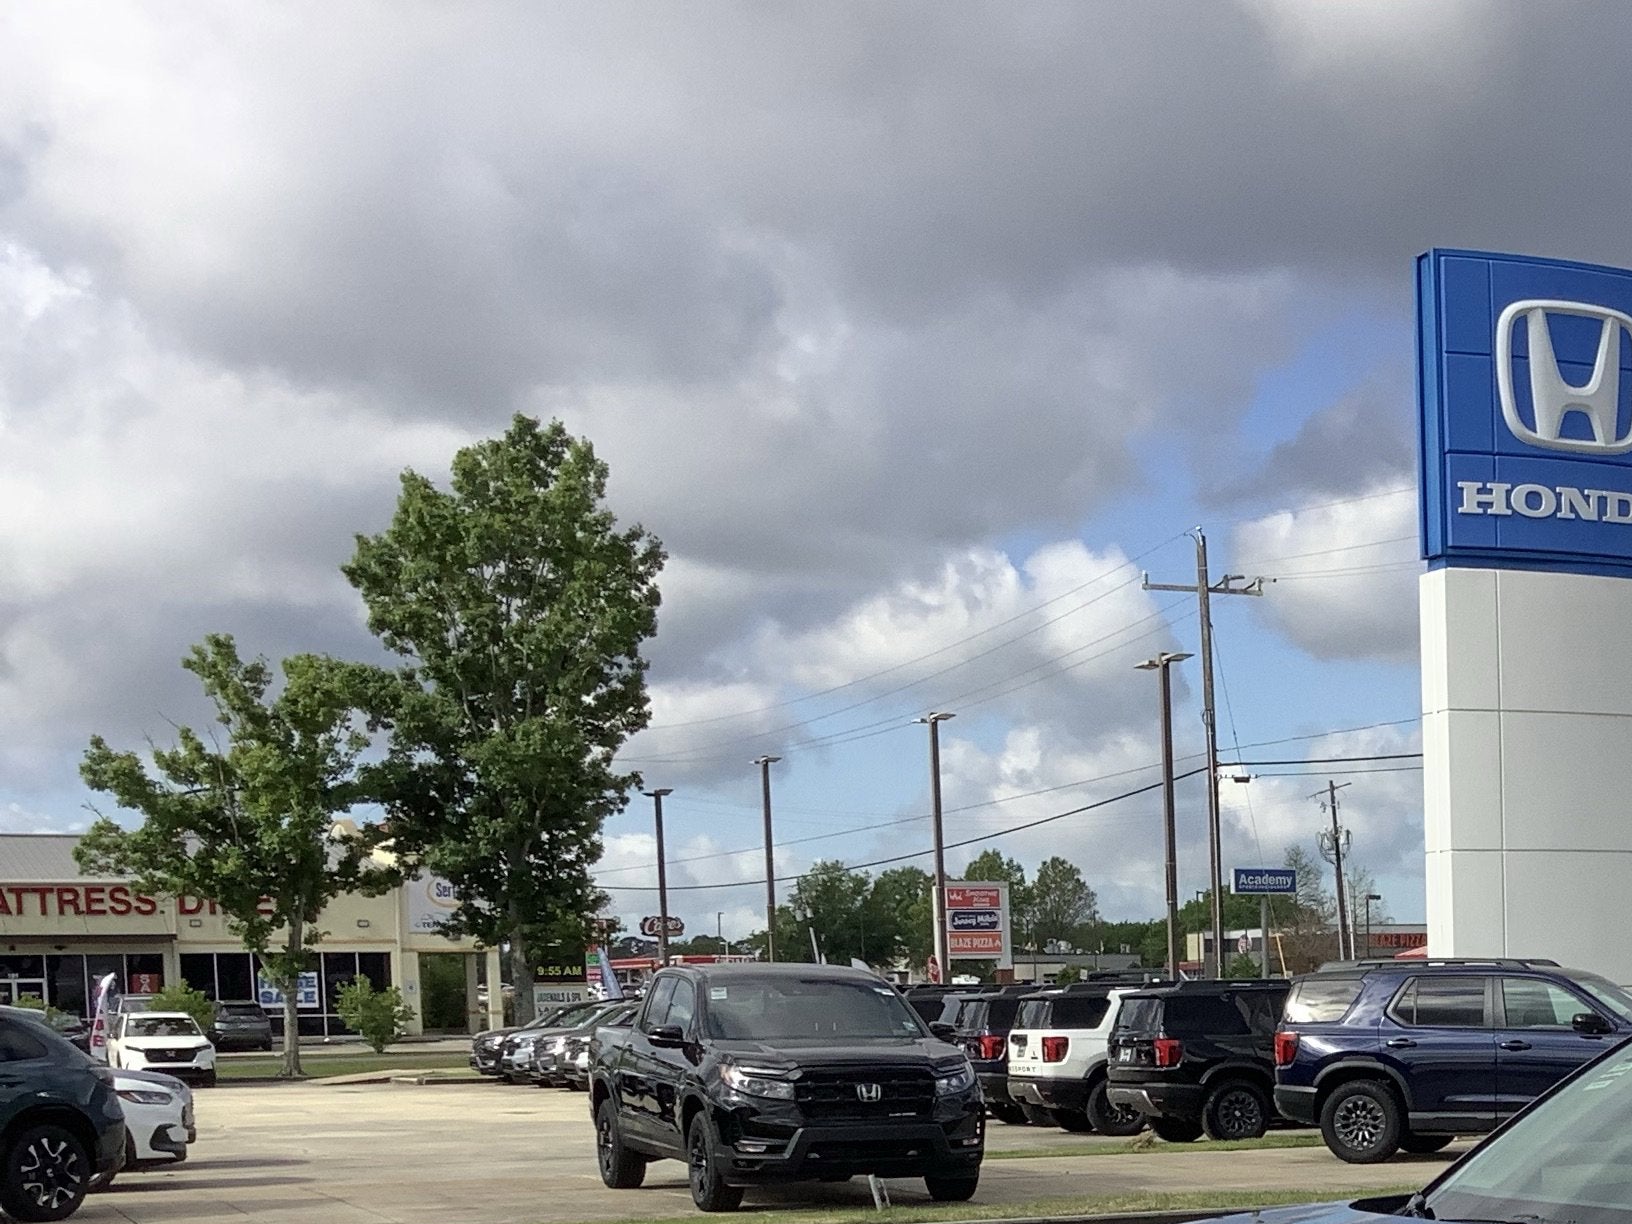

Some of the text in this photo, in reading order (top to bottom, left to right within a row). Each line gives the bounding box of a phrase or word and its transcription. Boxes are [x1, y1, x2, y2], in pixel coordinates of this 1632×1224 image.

[1239, 874, 1292, 888] Academy
[950, 938, 993, 949] BLAZE PIZZA
[537, 965, 582, 976] 9:55 AM
